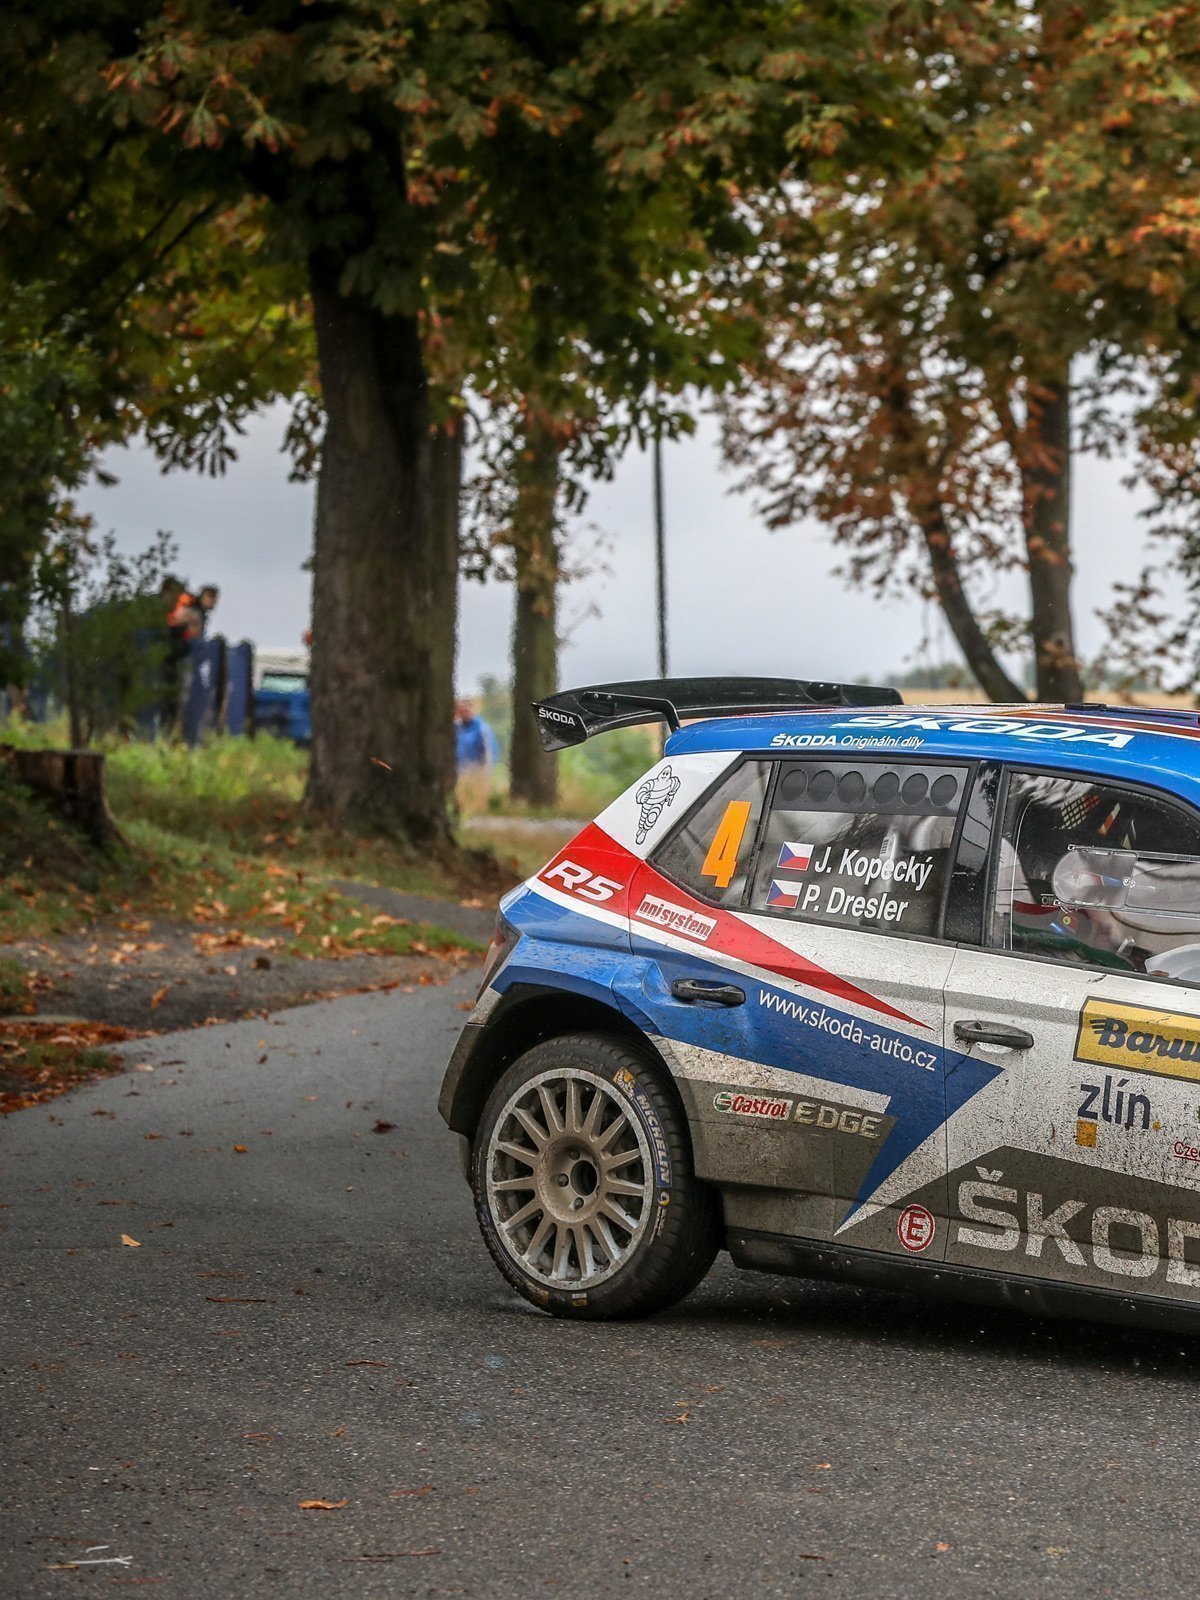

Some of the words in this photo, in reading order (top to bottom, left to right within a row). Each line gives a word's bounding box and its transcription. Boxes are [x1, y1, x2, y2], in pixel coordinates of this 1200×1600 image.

[538, 707, 576, 726] ŠKODA
[831, 714, 1135, 749] ŠKODA
[770, 733, 837, 747] ŠKODA
[840, 735, 901, 749] Originální
[901, 736, 925, 750] díly
[701, 800, 752, 888] 4
[544, 859, 625, 902] R5
[814, 846, 832, 874] J.
[838, 848, 934, 891] Kopecký
[801, 884, 821, 912] P.
[826, 887, 909, 922] Dresler
[759, 989, 938, 1072] www.skoda-auto.cz
[636, 1094, 671, 1184] MICHELIN
[732, 1095, 788, 1120] Castrol
[793, 1101, 883, 1140] EDGE
